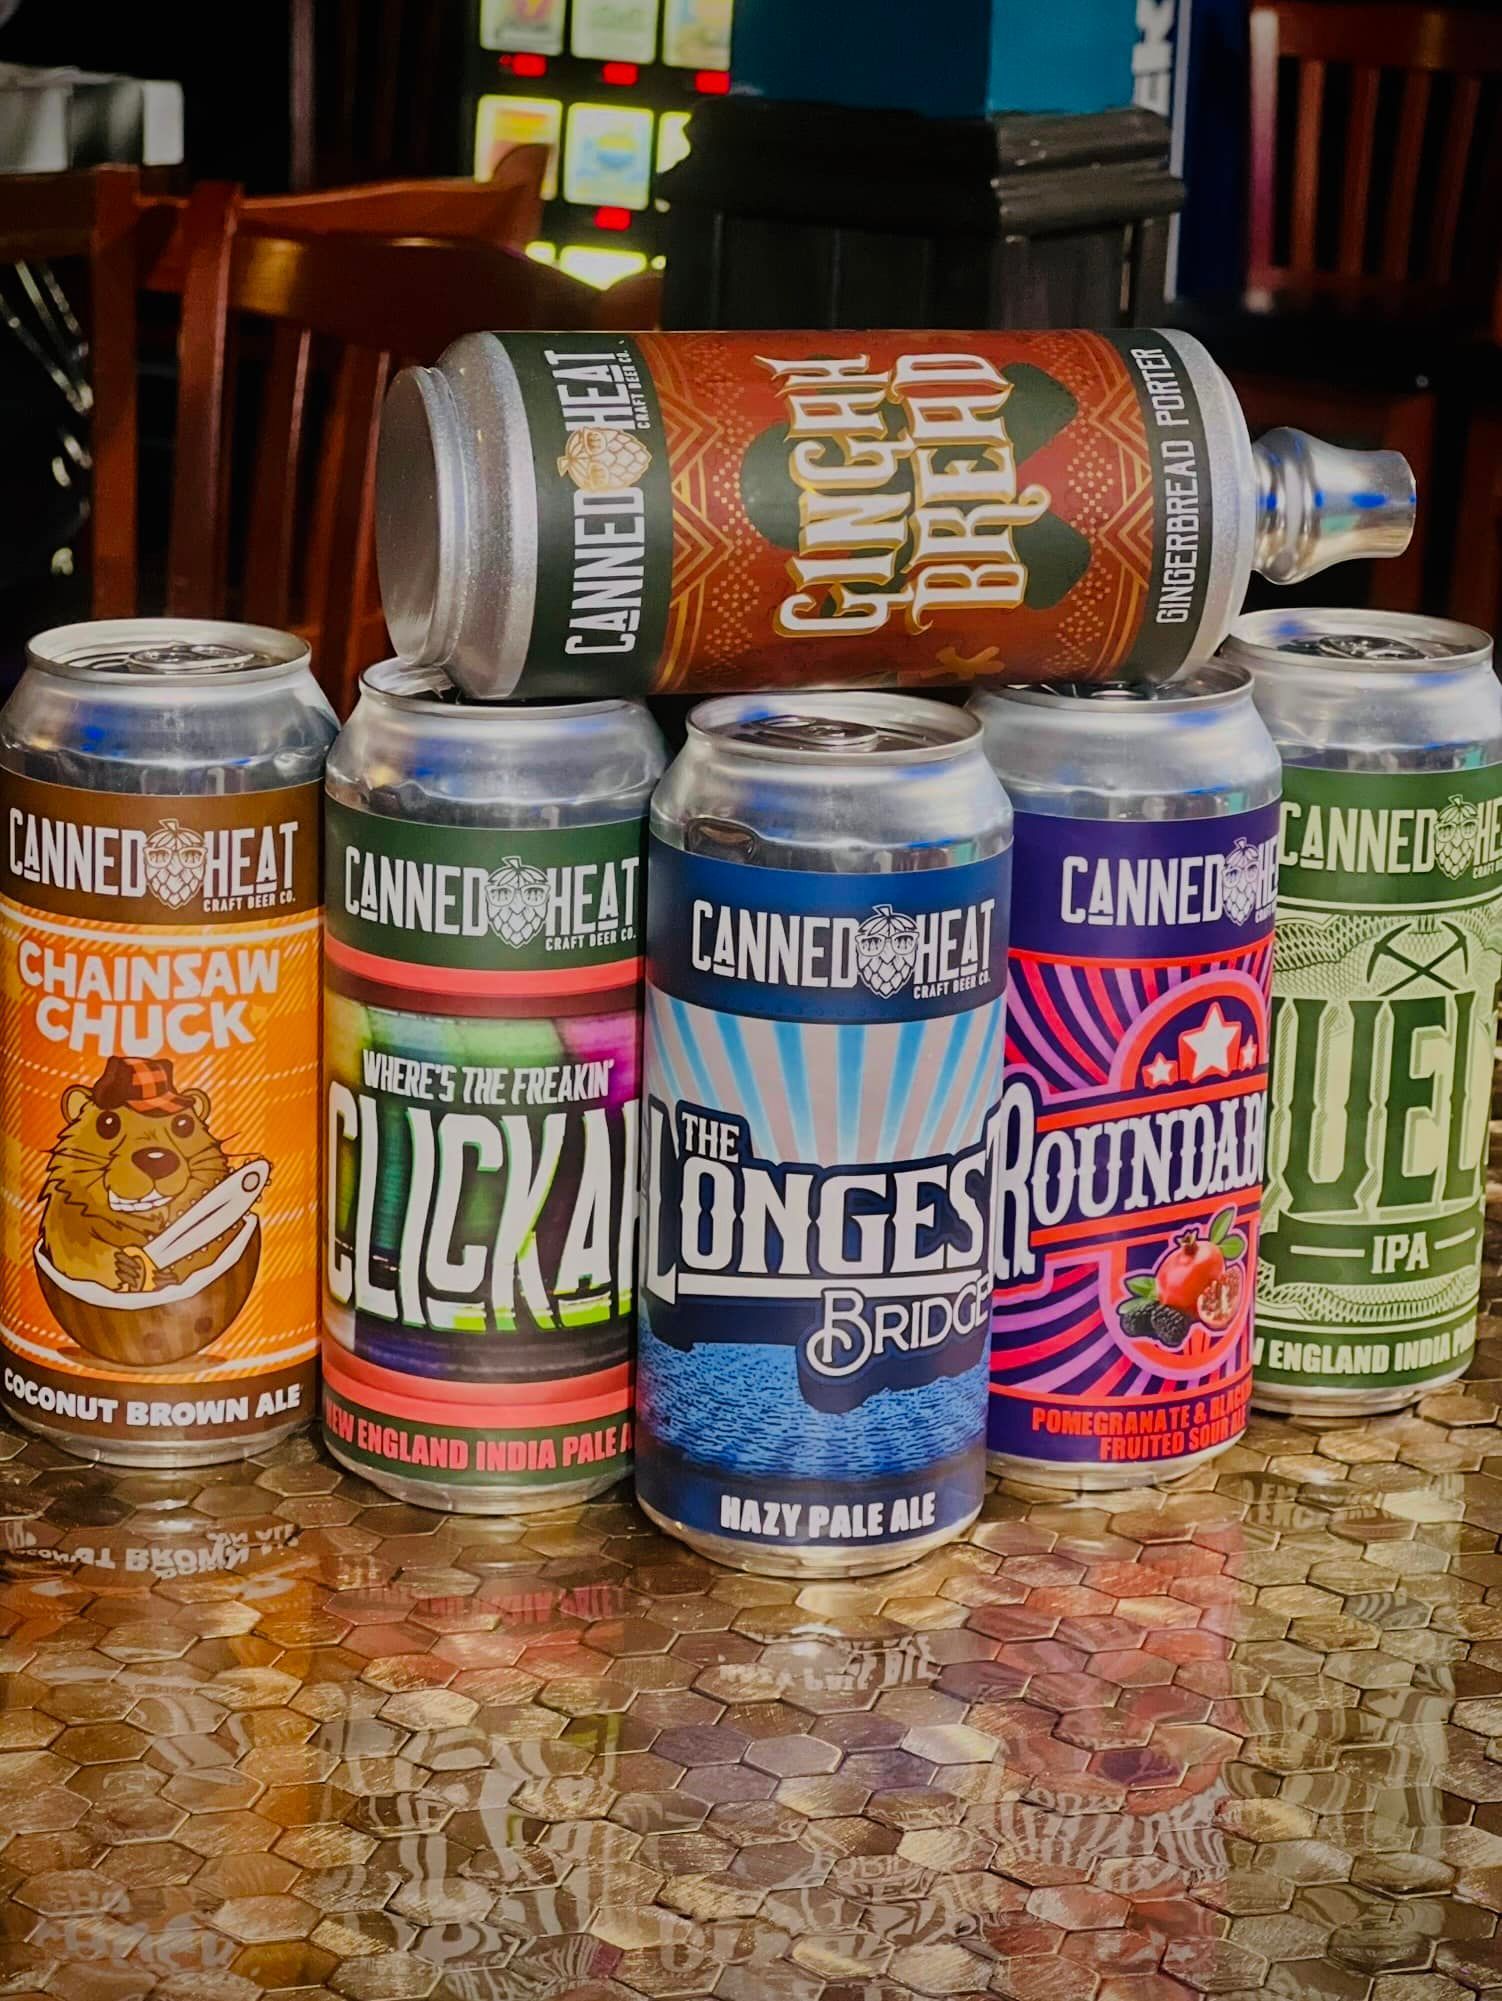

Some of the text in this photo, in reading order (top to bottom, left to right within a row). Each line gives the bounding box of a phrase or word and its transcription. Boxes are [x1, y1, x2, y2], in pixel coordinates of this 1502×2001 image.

[623, 365, 642, 392] BEER
[633, 392, 651, 431] CRAFT
[545, 349, 645, 655] CANNED HEAT
[903, 353, 1051, 634] BREAD
[1131, 347, 1201, 625] GINGERBREAD PORTER
[9, 807, 299, 898] CANNED HEAT
[1279, 801, 1439, 874] CANNED
[203, 896, 242, 912] CRAFT
[247, 892, 277, 910] BEER
[345, 846, 640, 937] CANNED HEAT
[1061, 854, 1226, 926] CANNED
[545, 934, 584, 951] CRAFT
[589, 930, 617, 948] BEER
[691, 898, 996, 988] CANNED HEAT
[19, 939, 280, 1002] CHAINSAW
[913, 982, 950, 1000] CRAFT
[953, 975, 977, 995] BEER
[36, 995, 256, 1057] CHUCK
[363, 1048, 615, 1106] WHERE'S THE FREAKIN'
[682, 1111, 740, 1163] THE
[1371, 1231, 1429, 1275] IPA
[807, 1272, 993, 1377] BRIDGE
[1268, 1339, 1390, 1374] ENGLAND
[1393, 1332, 1452, 1372] INDIA
[4, 1367, 301, 1427] COCONUT BROWN ALE
[1031, 1404, 1190, 1436] POMEGRANATE
[1193, 1401, 1207, 1425] &
[357, 1418, 469, 1470] ENGLAND
[476, 1438, 556, 1472] INDIA
[562, 1429, 618, 1468] PALE
[1100, 1431, 1185, 1461] FRUITED
[1189, 1416, 1230, 1451] SOUR
[720, 1491, 936, 1538] HAZY PALE ALE
